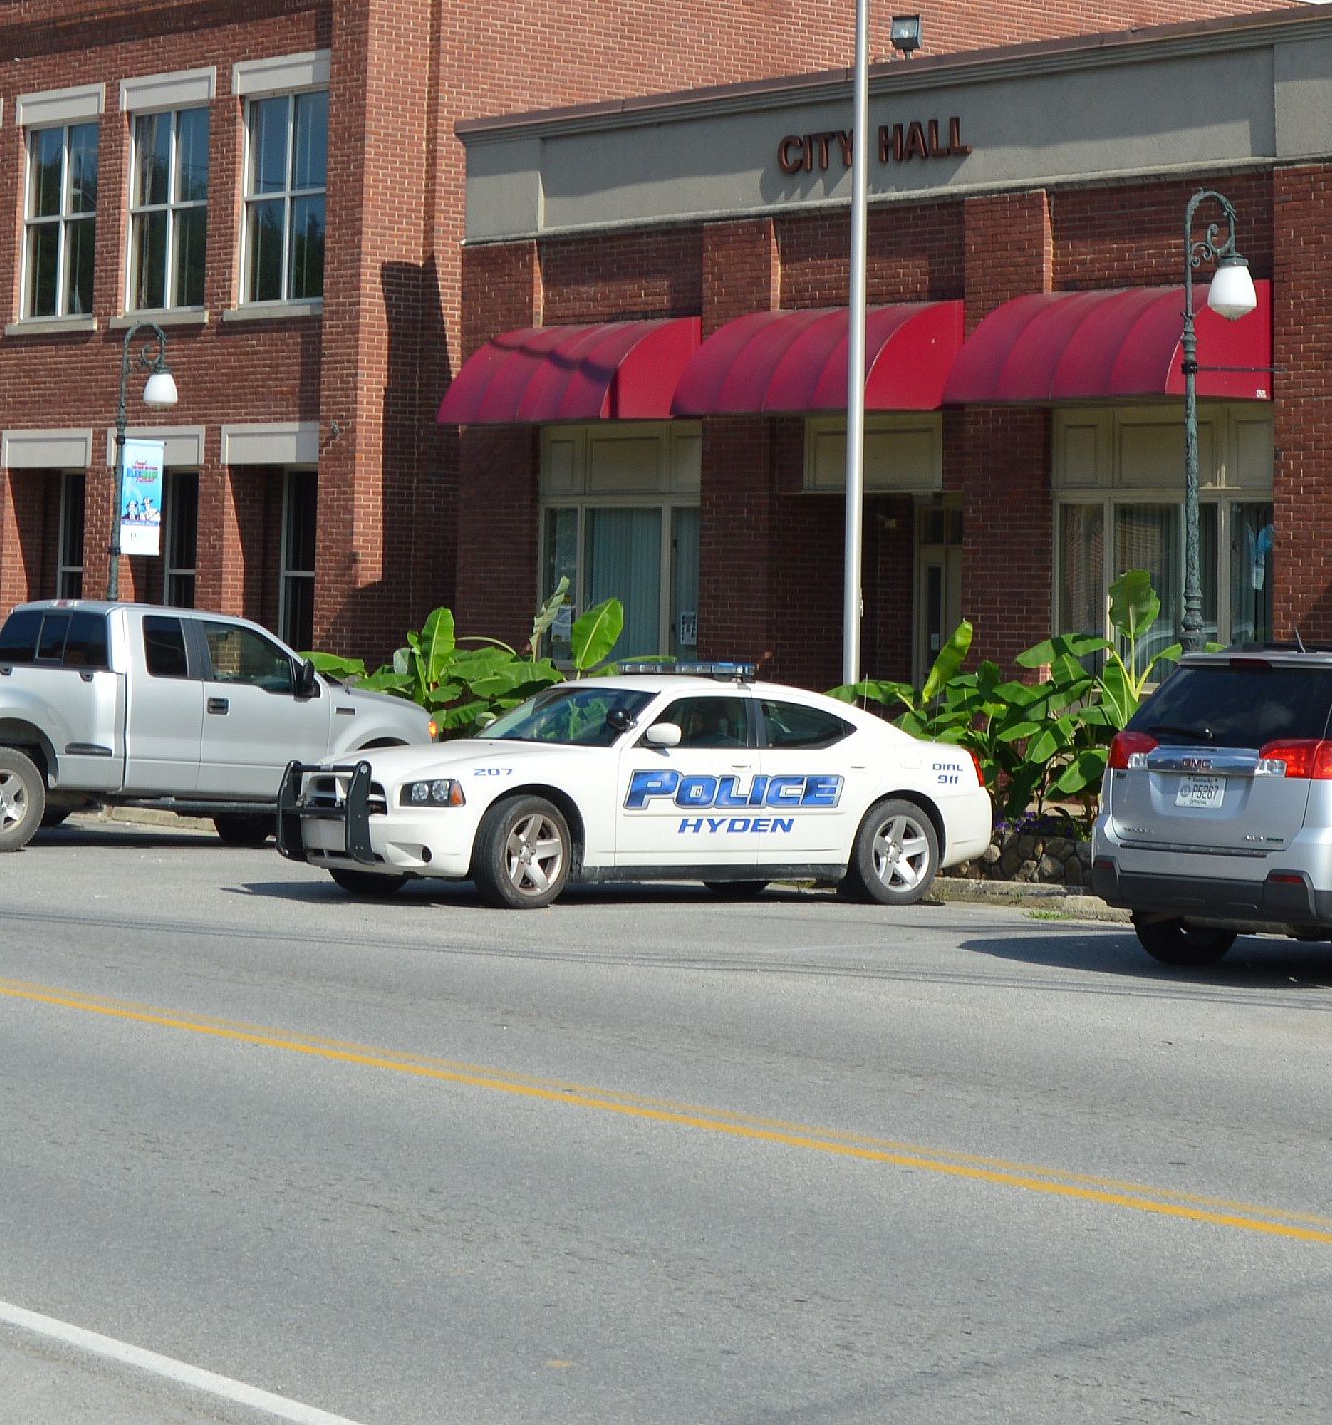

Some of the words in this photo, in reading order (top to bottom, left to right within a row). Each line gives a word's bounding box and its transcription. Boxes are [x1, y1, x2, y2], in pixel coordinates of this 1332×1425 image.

[777, 129, 854, 175] CITY
[878, 116, 973, 164] HALL
[474, 768, 514, 777] 207
[932, 763, 963, 773] DIAL
[938, 774, 958, 785] 911
[623, 769, 845, 811] POLICE
[677, 818, 795, 834] HYDEN
